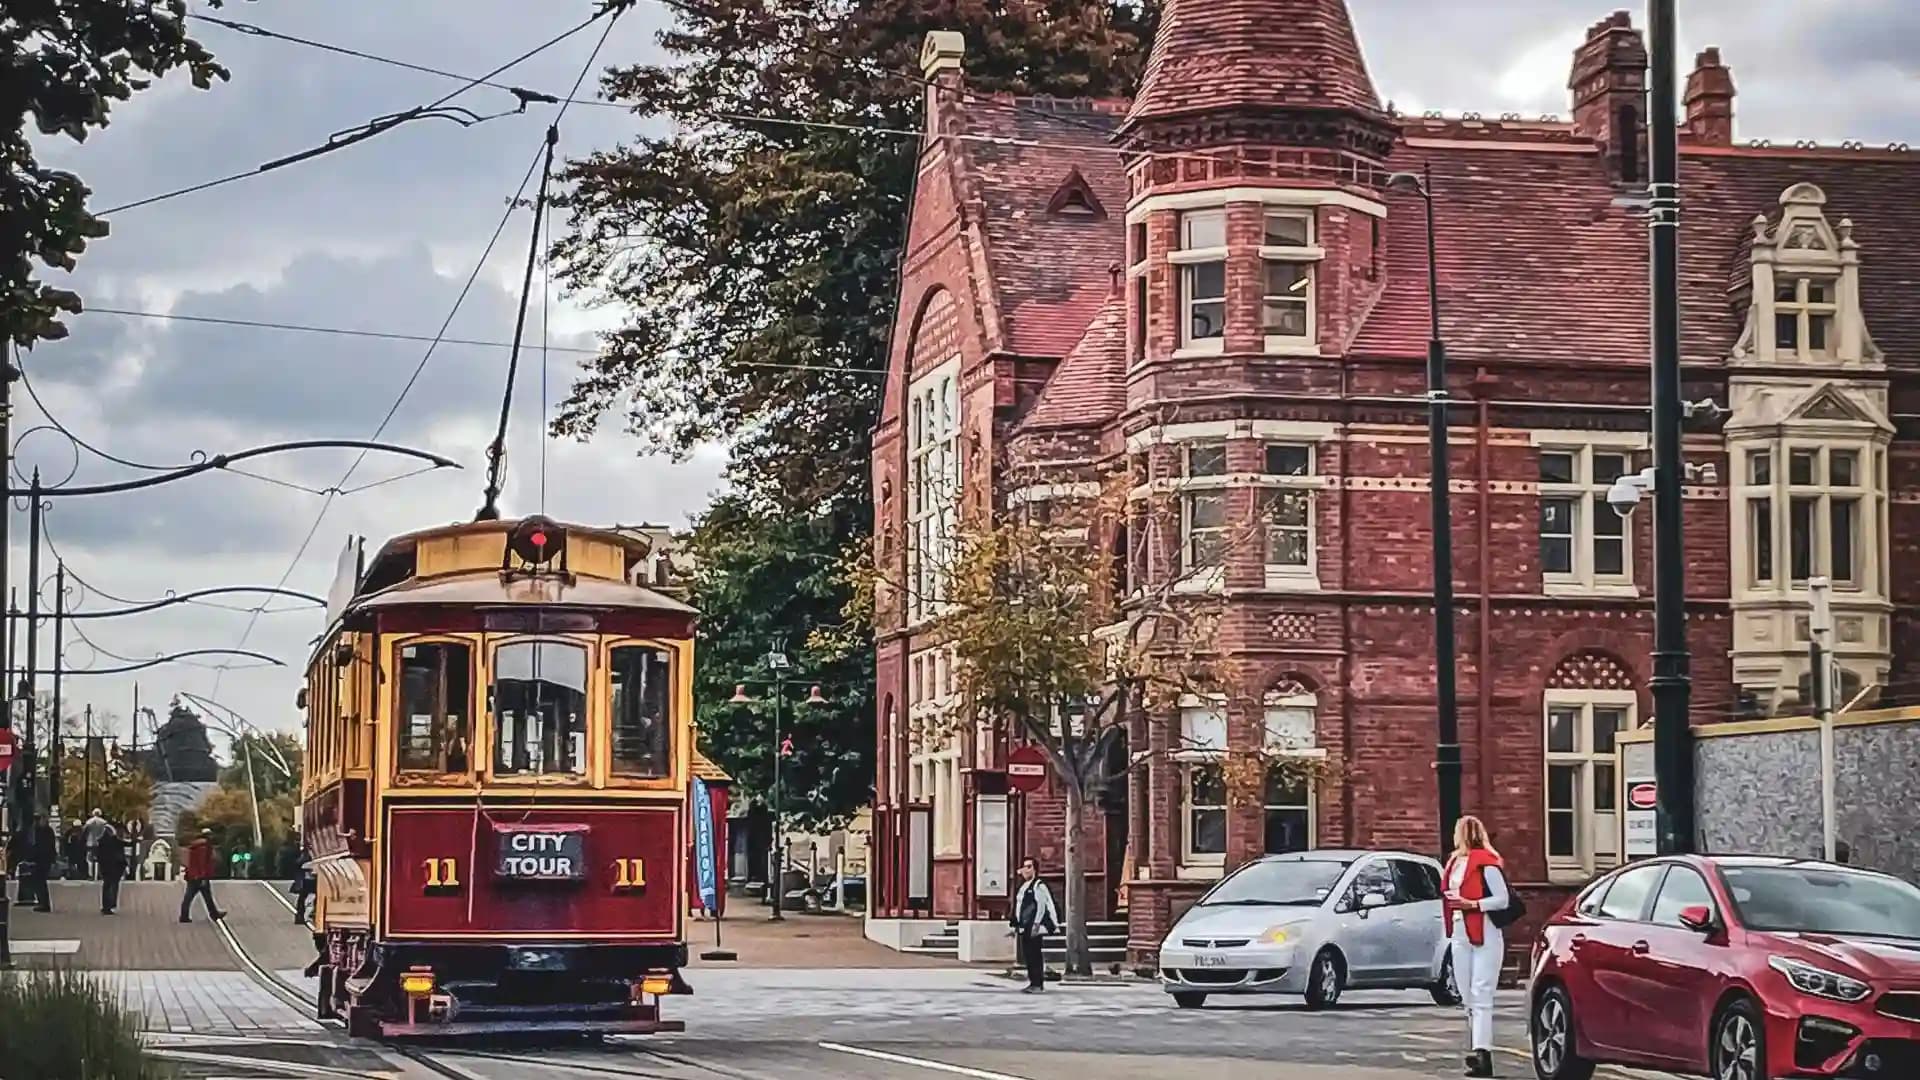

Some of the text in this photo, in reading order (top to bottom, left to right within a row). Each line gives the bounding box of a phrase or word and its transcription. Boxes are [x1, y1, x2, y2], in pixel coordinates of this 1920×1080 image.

[511, 833, 567, 852] CITY
[425, 858, 460, 886] 11
[505, 857, 571, 875] TOUR
[615, 858, 646, 886] 11
